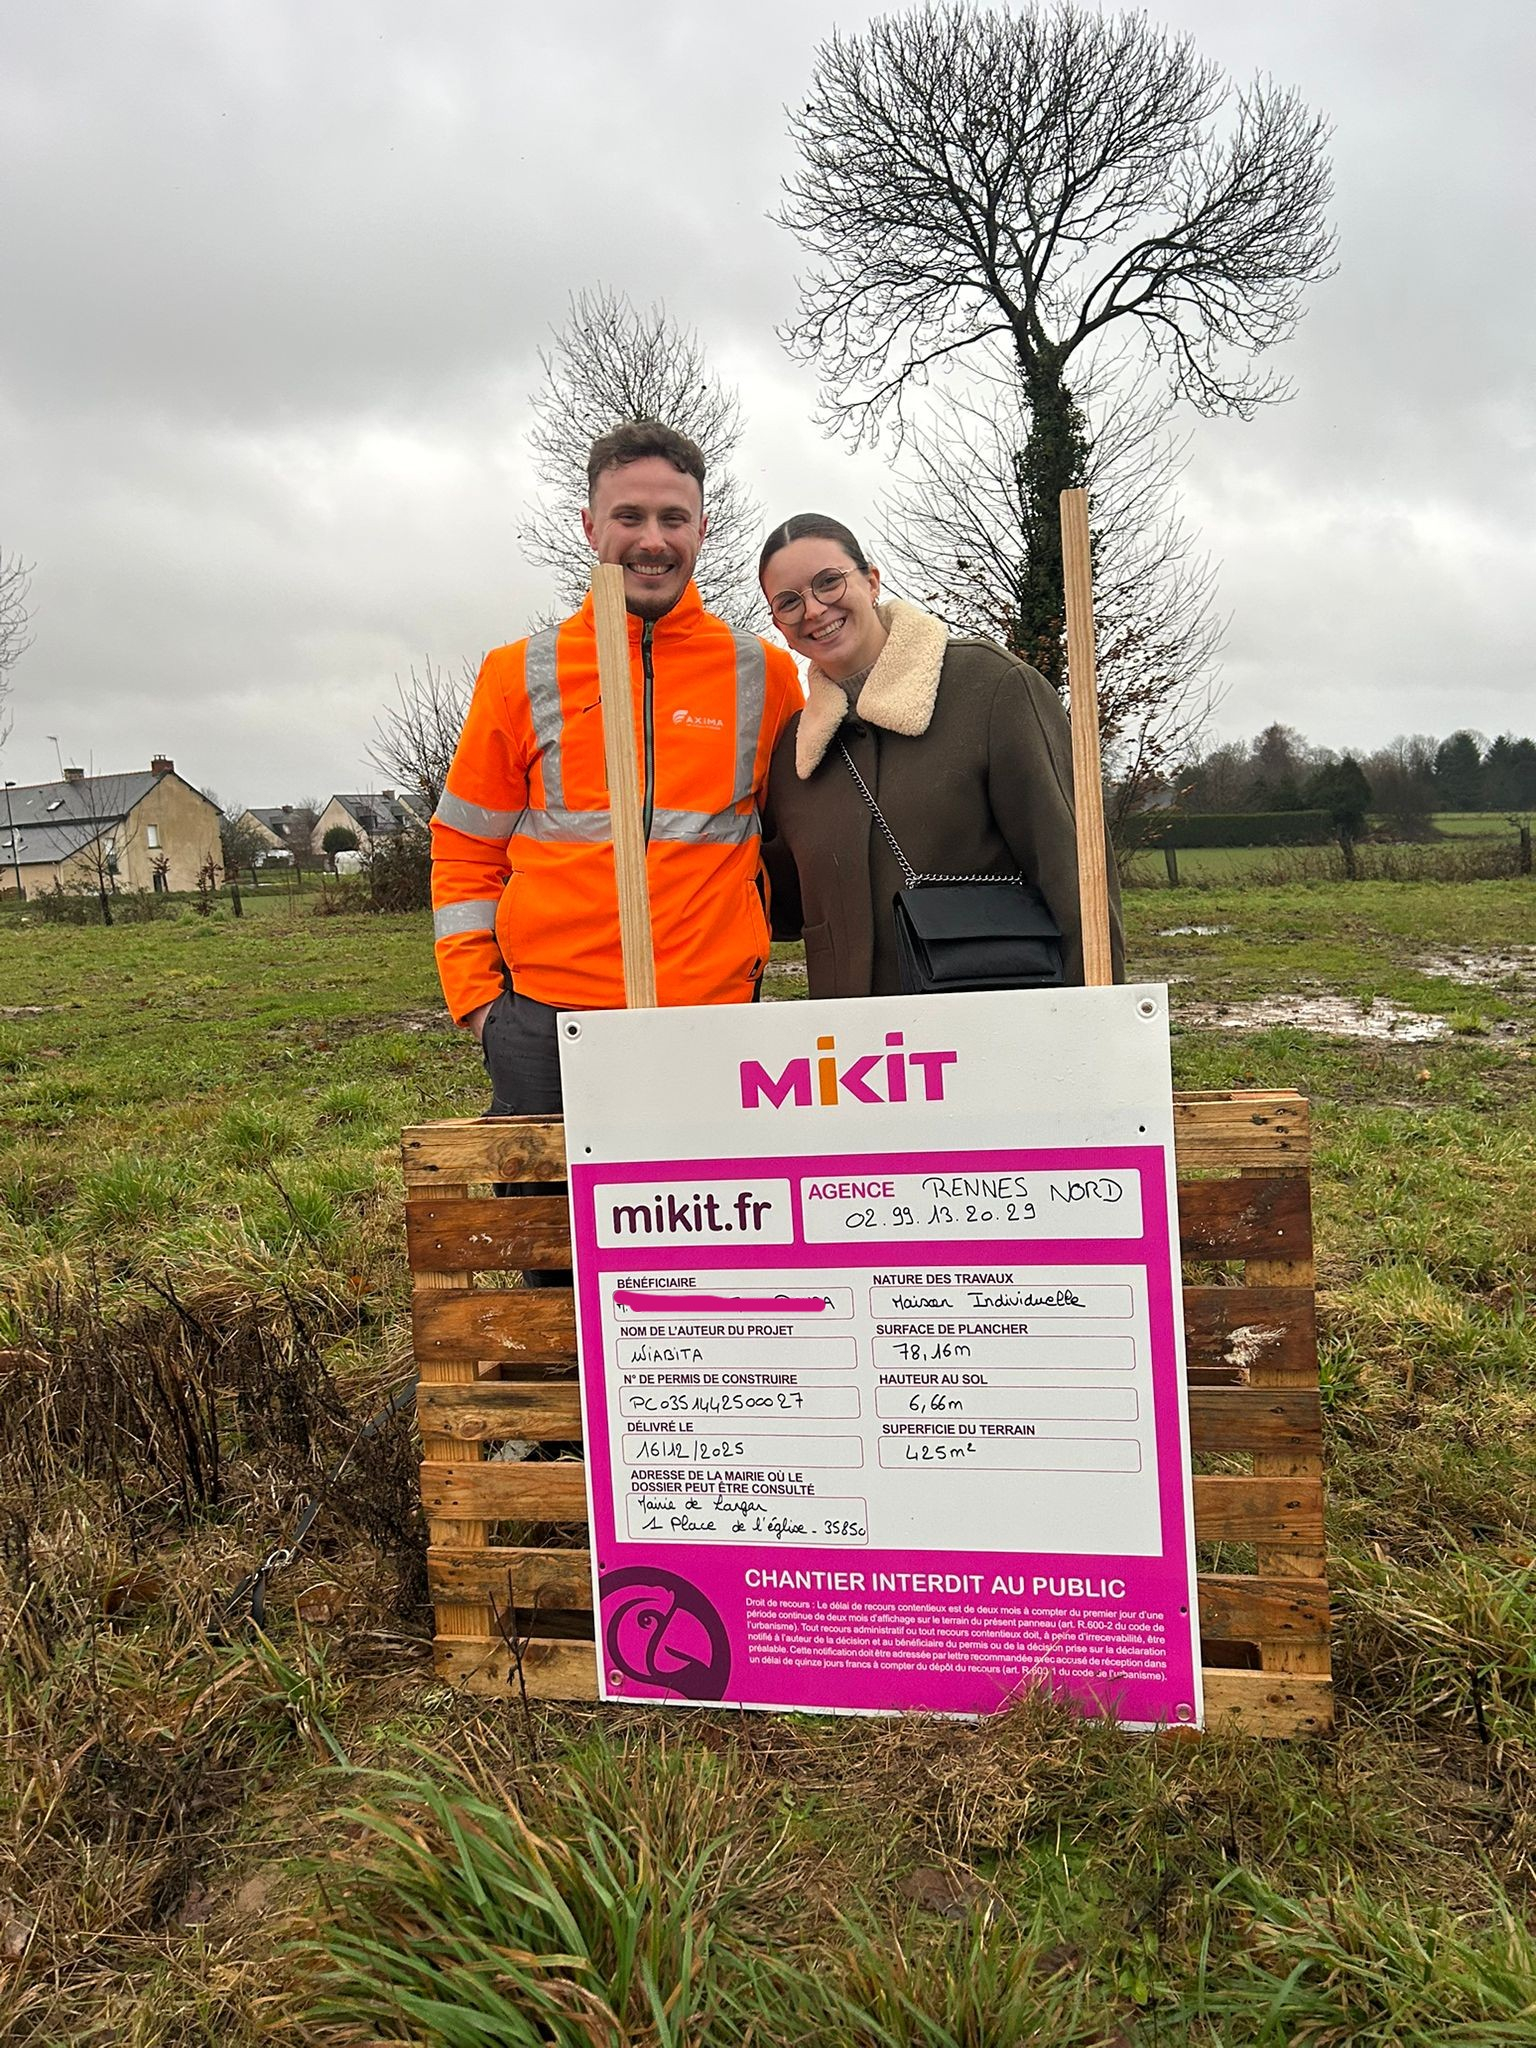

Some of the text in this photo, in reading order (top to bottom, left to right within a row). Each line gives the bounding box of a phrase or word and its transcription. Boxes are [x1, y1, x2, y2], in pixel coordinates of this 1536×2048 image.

[808, 1176, 1123, 1203] AGENCE RENNES NORD
[612, 1191, 772, 1234] mikit.fr
[617, 1277, 696, 1289] BÉNÉFICIAIRE
[872, 1273, 1014, 1285] NATURE DES TRAVAUX
[892, 1288, 1086, 1311] Maison Individuelle
[620, 1325, 794, 1337] NOM DE L'AUTEUR DU PROJET
[876, 1323, 1028, 1335] SURFACE DE PLANCHER
[623, 1374, 798, 1385] N° DE PERMIS DE CONSTRUIRE
[879, 1374, 988, 1385] HAUTEUR AU SOL
[627, 1422, 694, 1432] DÉLIVRÉ LE
[882, 1424, 1036, 1436] SUPERFICIE DU TERRAIN
[631, 1469, 803, 1483] ADRESSE DE LA MAIRIE OÙ LE
[631, 1481, 815, 1495] DOSSIER PEUT ÊTRE CONSULTÉ
[637, 1495, 676, 1514] Mairie
[685, 1497, 703, 1510] de
[642, 1516, 663, 1530] 1
[670, 1516, 717, 1532] Place
[732, 1520, 747, 1533] de
[752, 1516, 808, 1539] l'église
[824, 1520, 866, 1537] 35850
[745, 1568, 1126, 1598] CHANTIER INTERDIT AU PUBLIC
